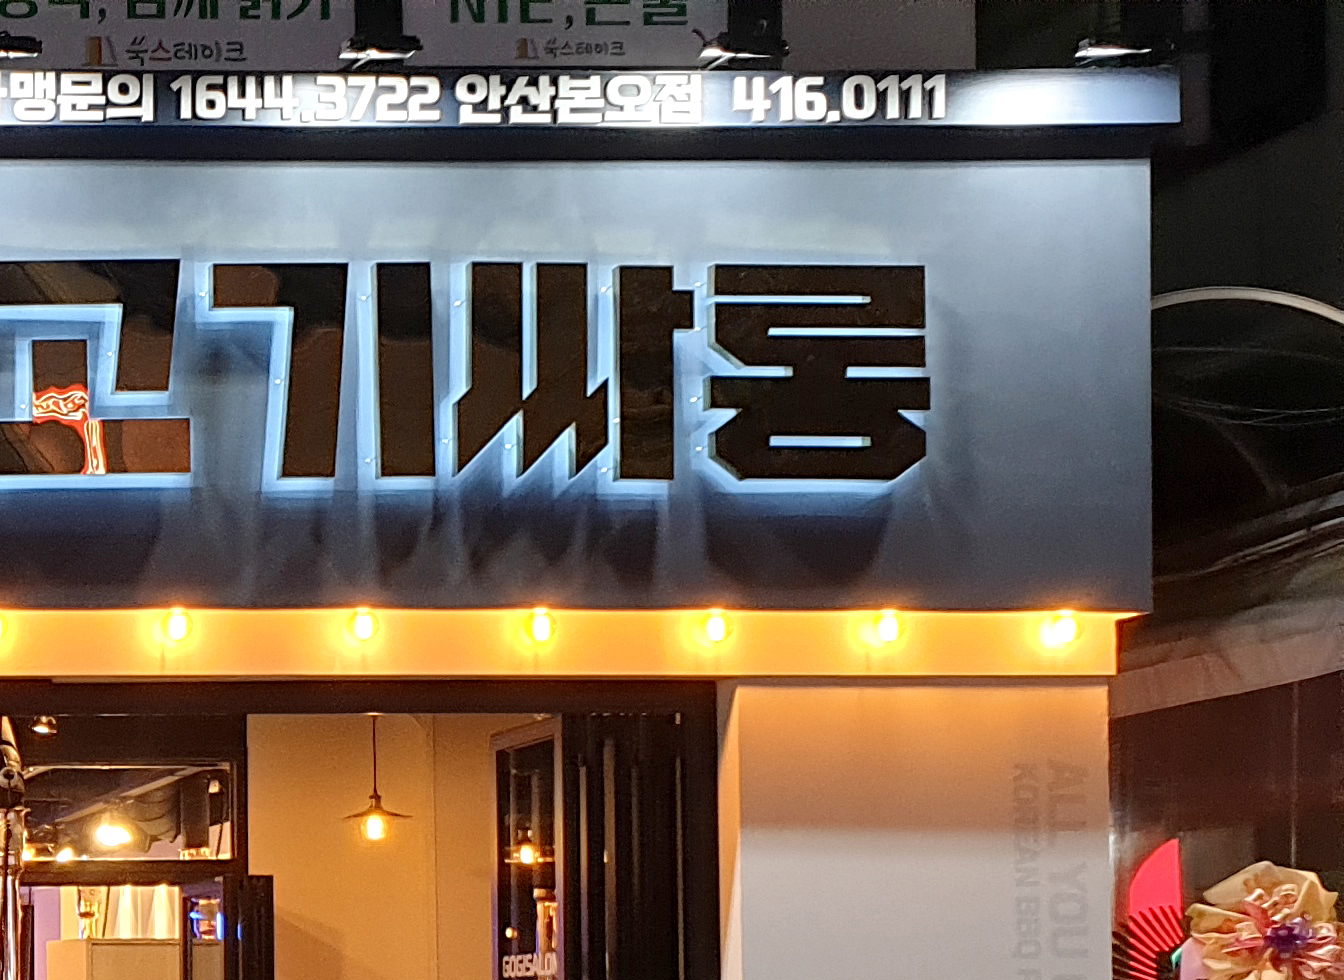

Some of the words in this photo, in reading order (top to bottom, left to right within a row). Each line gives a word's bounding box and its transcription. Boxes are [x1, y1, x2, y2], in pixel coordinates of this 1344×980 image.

[455, 73, 703, 124] 안산본오점
[1012, 762, 1040, 888] KOREAN
[1012, 895, 1042, 961] BBQ
[1049, 861, 1090, 960] YOU
